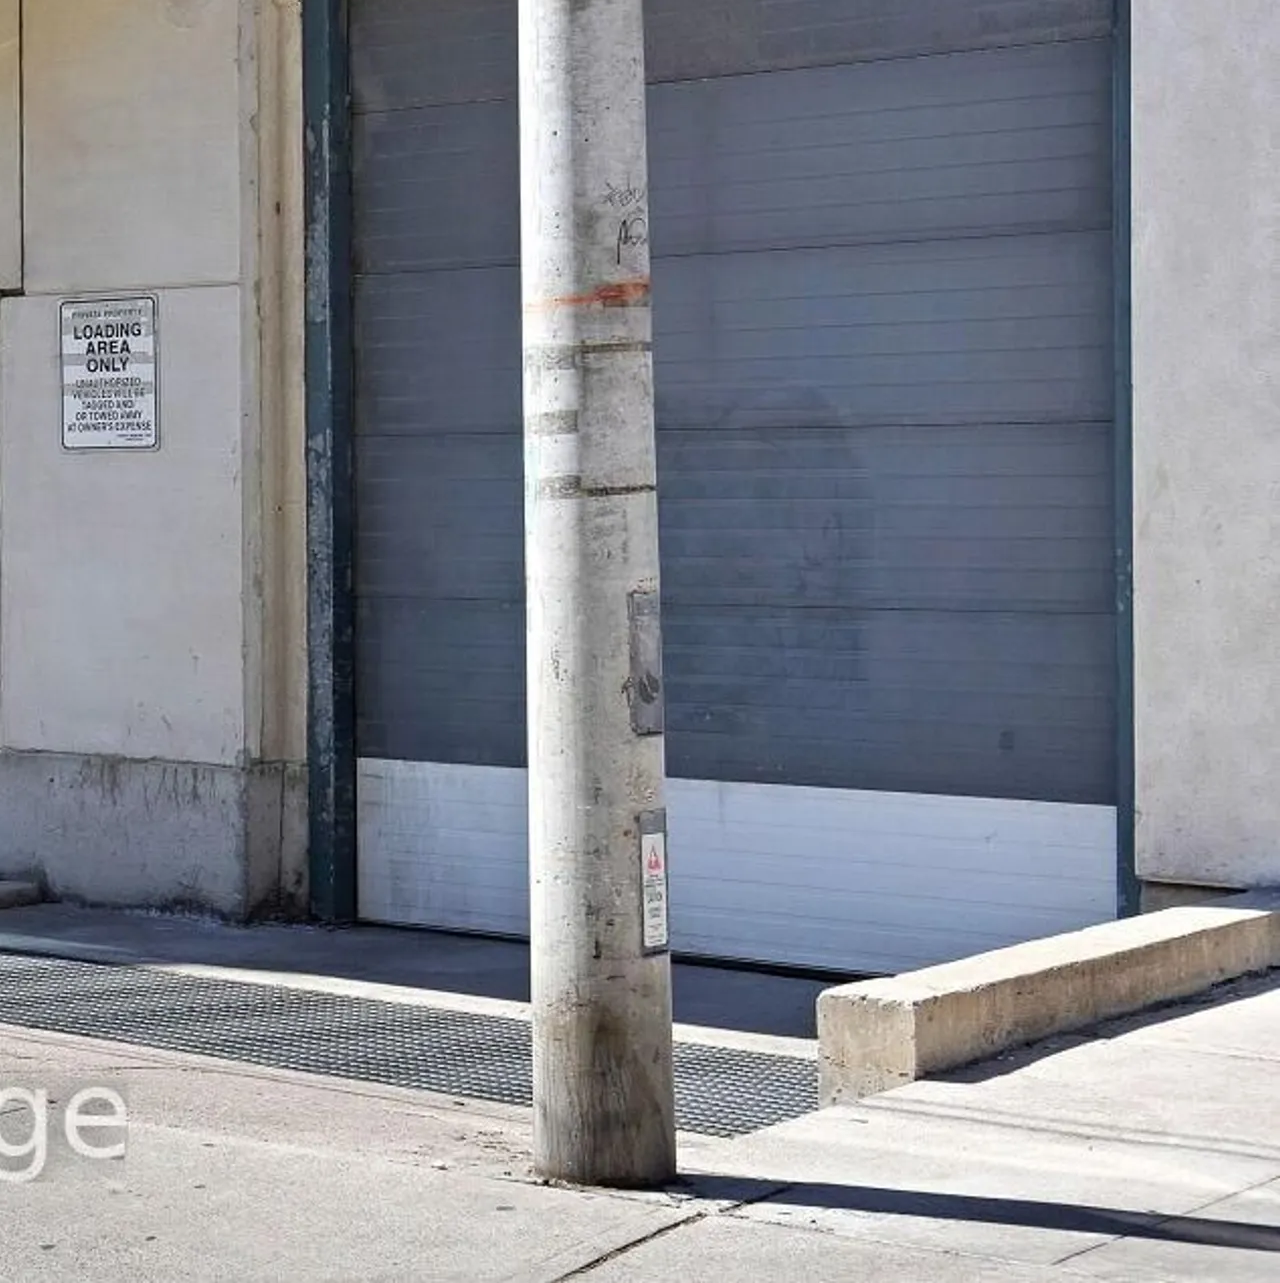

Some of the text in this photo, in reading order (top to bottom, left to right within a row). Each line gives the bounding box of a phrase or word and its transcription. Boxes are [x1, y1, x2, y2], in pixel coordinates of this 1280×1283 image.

[73, 322, 142, 340] LOADING
[86, 340, 131, 355] AREA
[86, 357, 129, 372] ONLY
[89, 411, 119, 420] TOWED
[115, 420, 152, 431] EXPENSE
